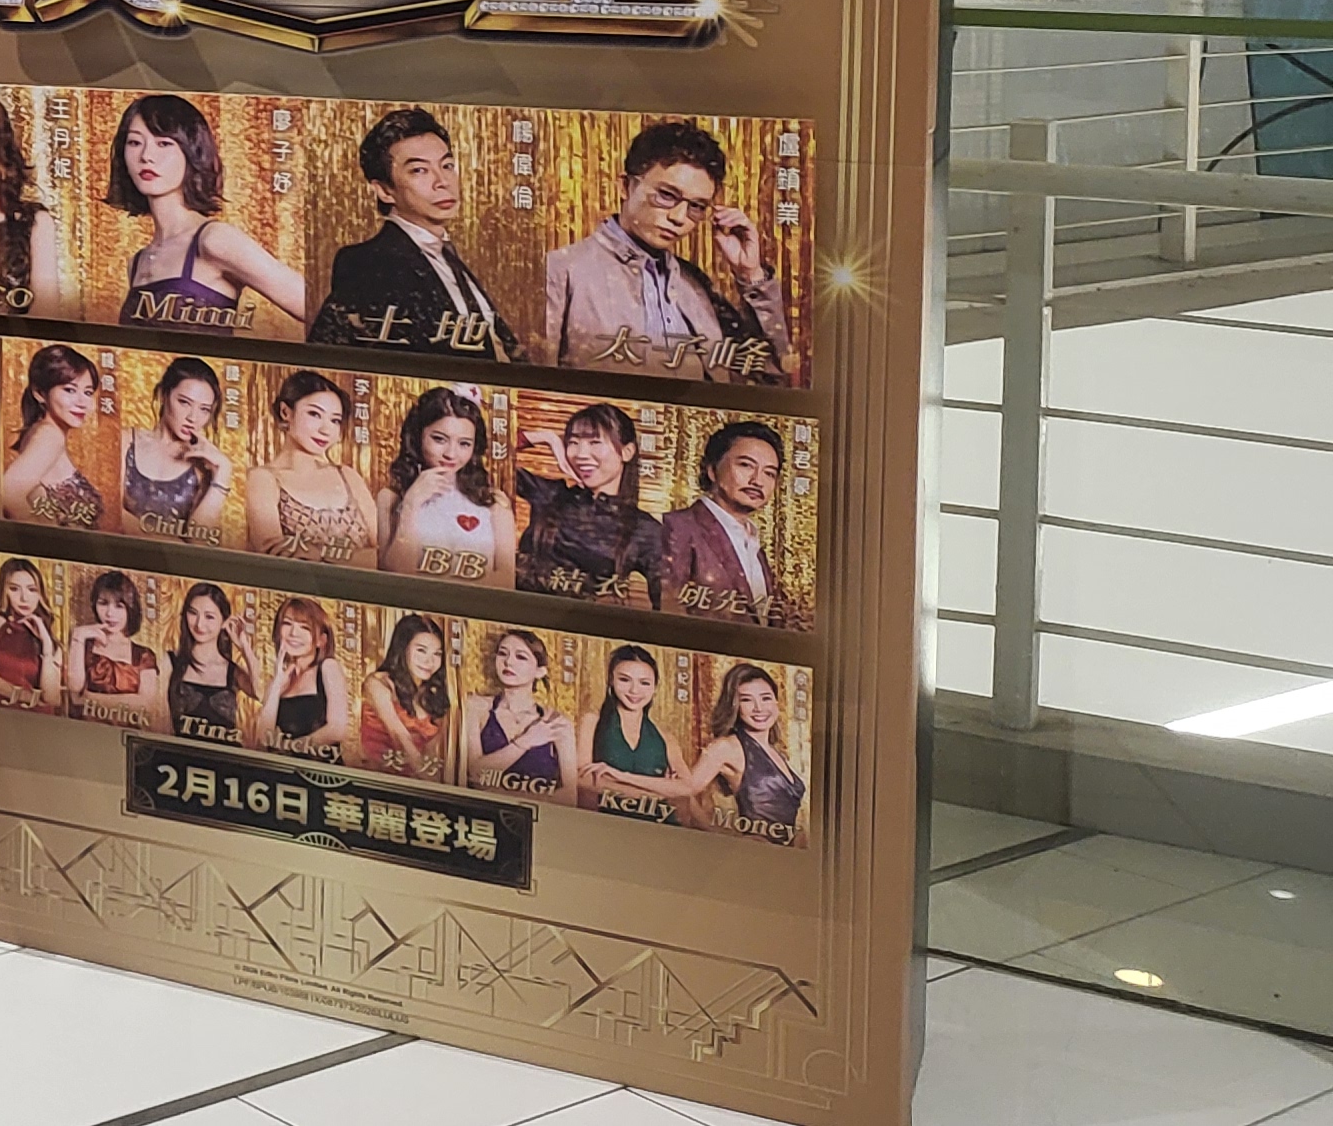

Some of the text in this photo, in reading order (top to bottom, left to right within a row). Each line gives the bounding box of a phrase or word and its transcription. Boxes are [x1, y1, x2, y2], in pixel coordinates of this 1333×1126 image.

[50, 97, 72, 180] 王丹妮
[83, 699, 151, 727] Horlick
[180, 715, 244, 744] Tina
[263, 729, 343, 764] Mickey
[157, 764, 499, 862] 2月16日 華麗登場
[599, 790, 678, 824] Kelly
[712, 806, 802, 847] Money
